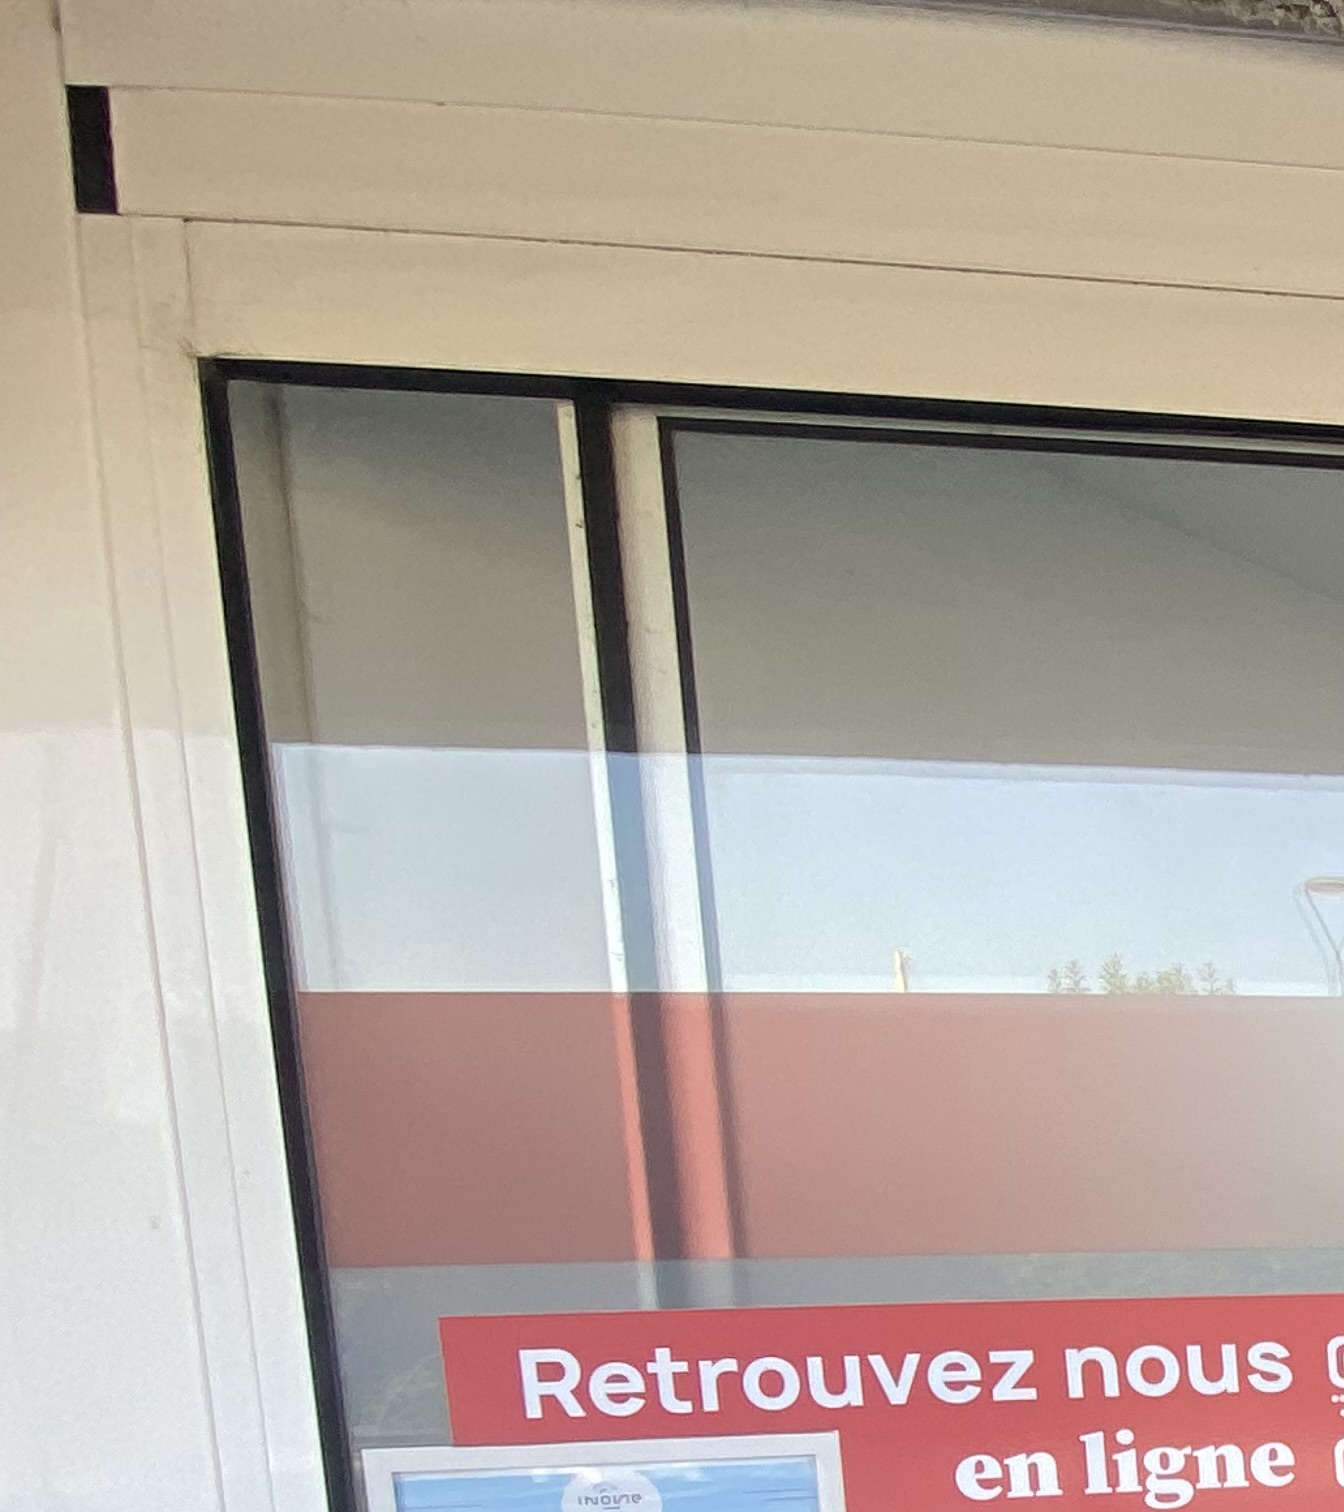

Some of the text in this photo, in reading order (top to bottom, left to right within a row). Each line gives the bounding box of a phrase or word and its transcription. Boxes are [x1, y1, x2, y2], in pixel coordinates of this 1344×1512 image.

[519, 1341, 1293, 1418] Retrouvez nous
[955, 1429, 1295, 1509] en ligne
